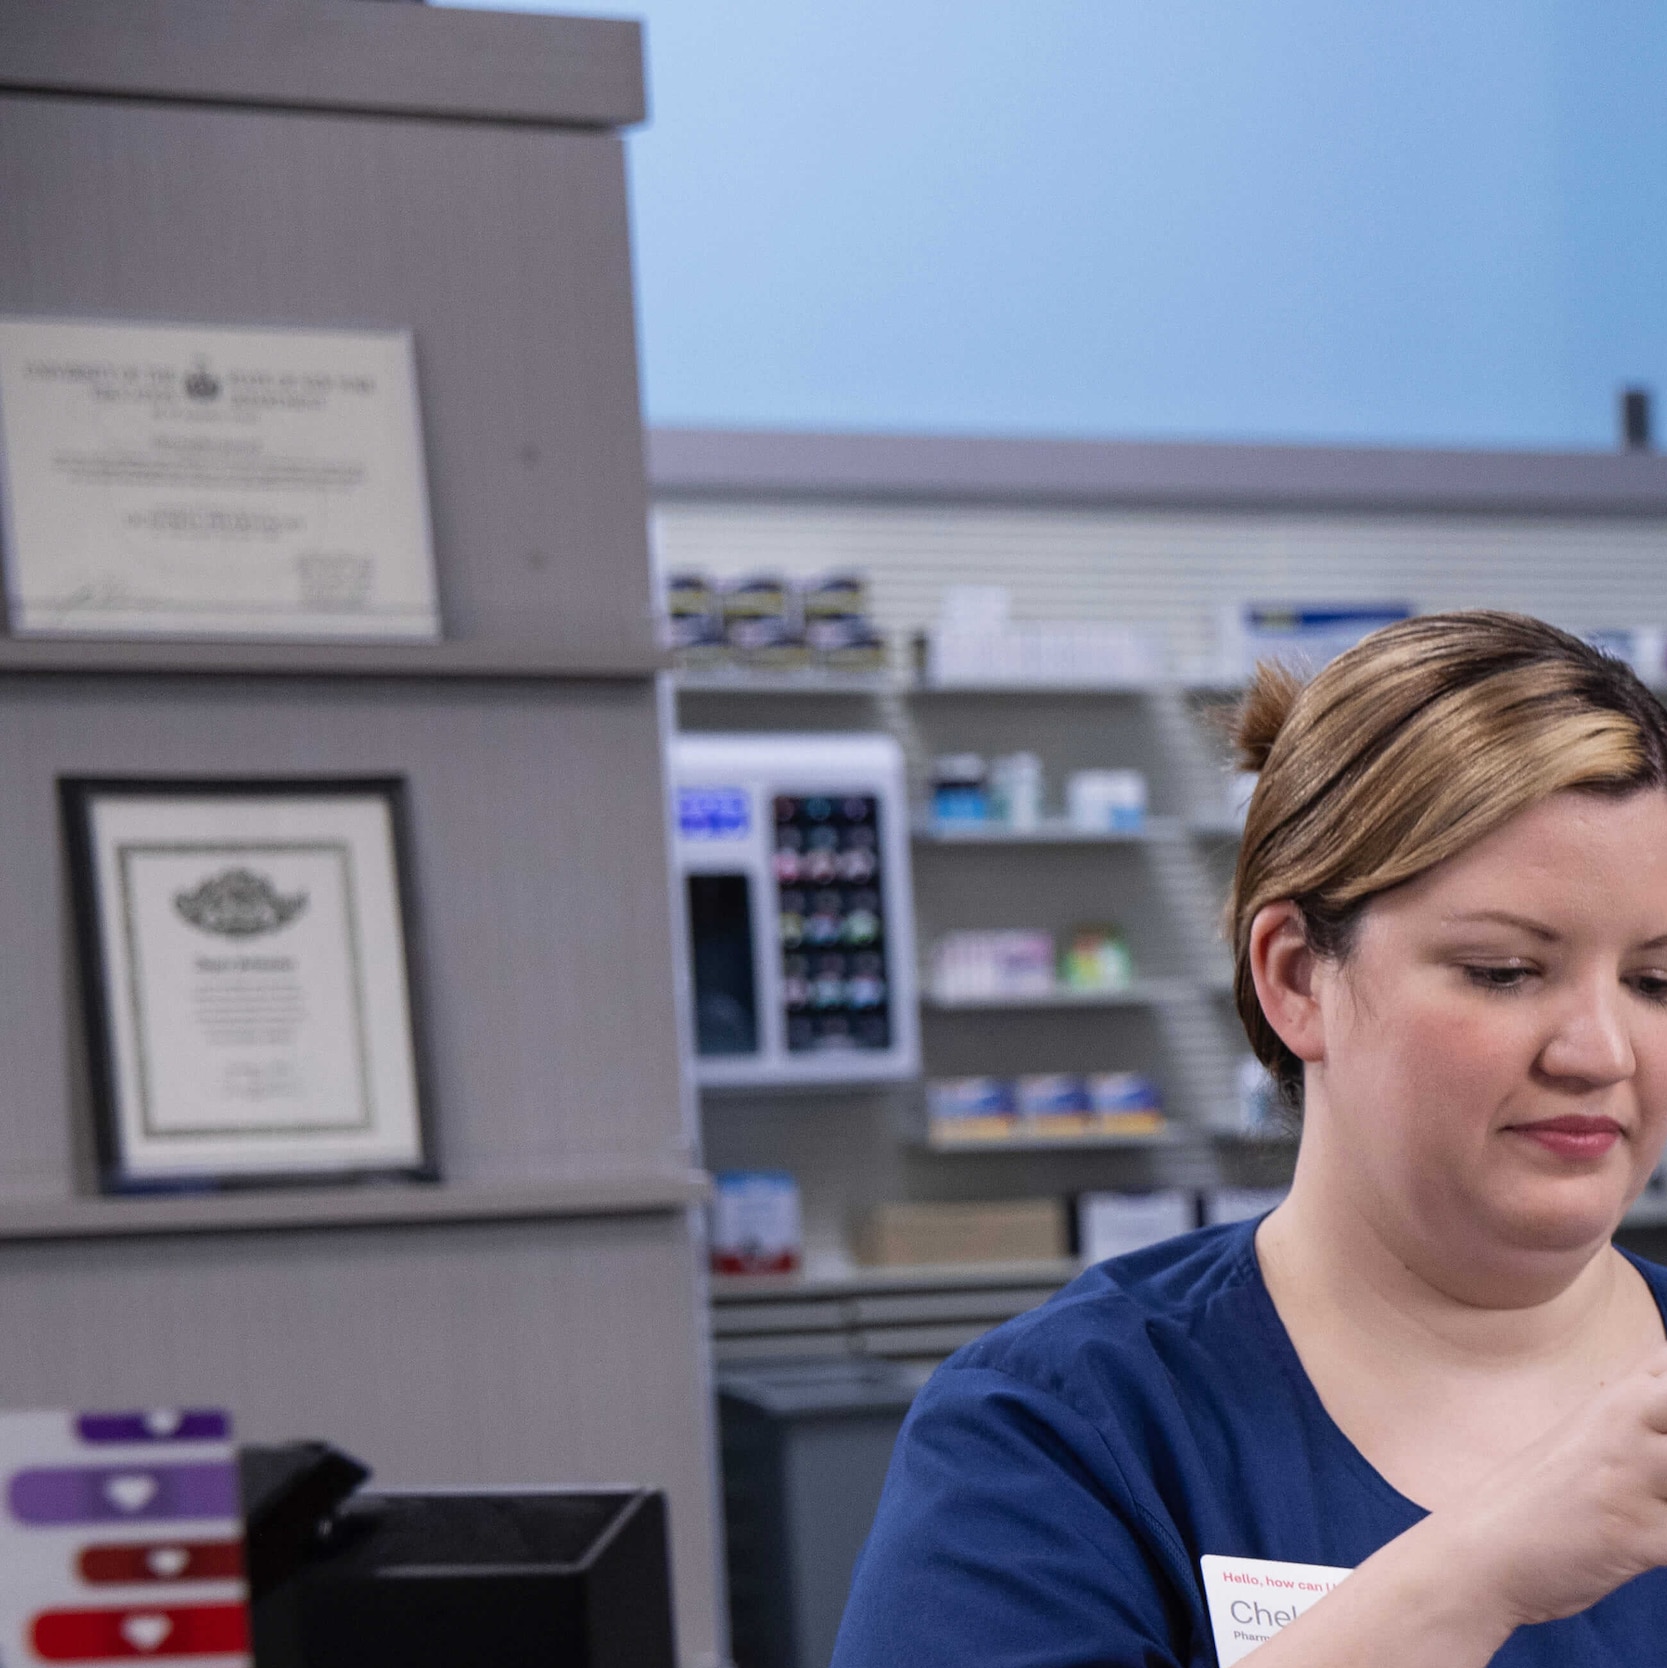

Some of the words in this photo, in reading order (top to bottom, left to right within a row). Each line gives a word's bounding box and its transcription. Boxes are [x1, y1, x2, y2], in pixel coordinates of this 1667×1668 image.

[1223, 1571, 1263, 1587] Hello,
[1266, 1576, 1294, 1589] how
[1298, 1581, 1323, 1592] can
[1230, 1600, 1298, 1628] Chel
[1234, 1631, 1270, 1642] Pharm
